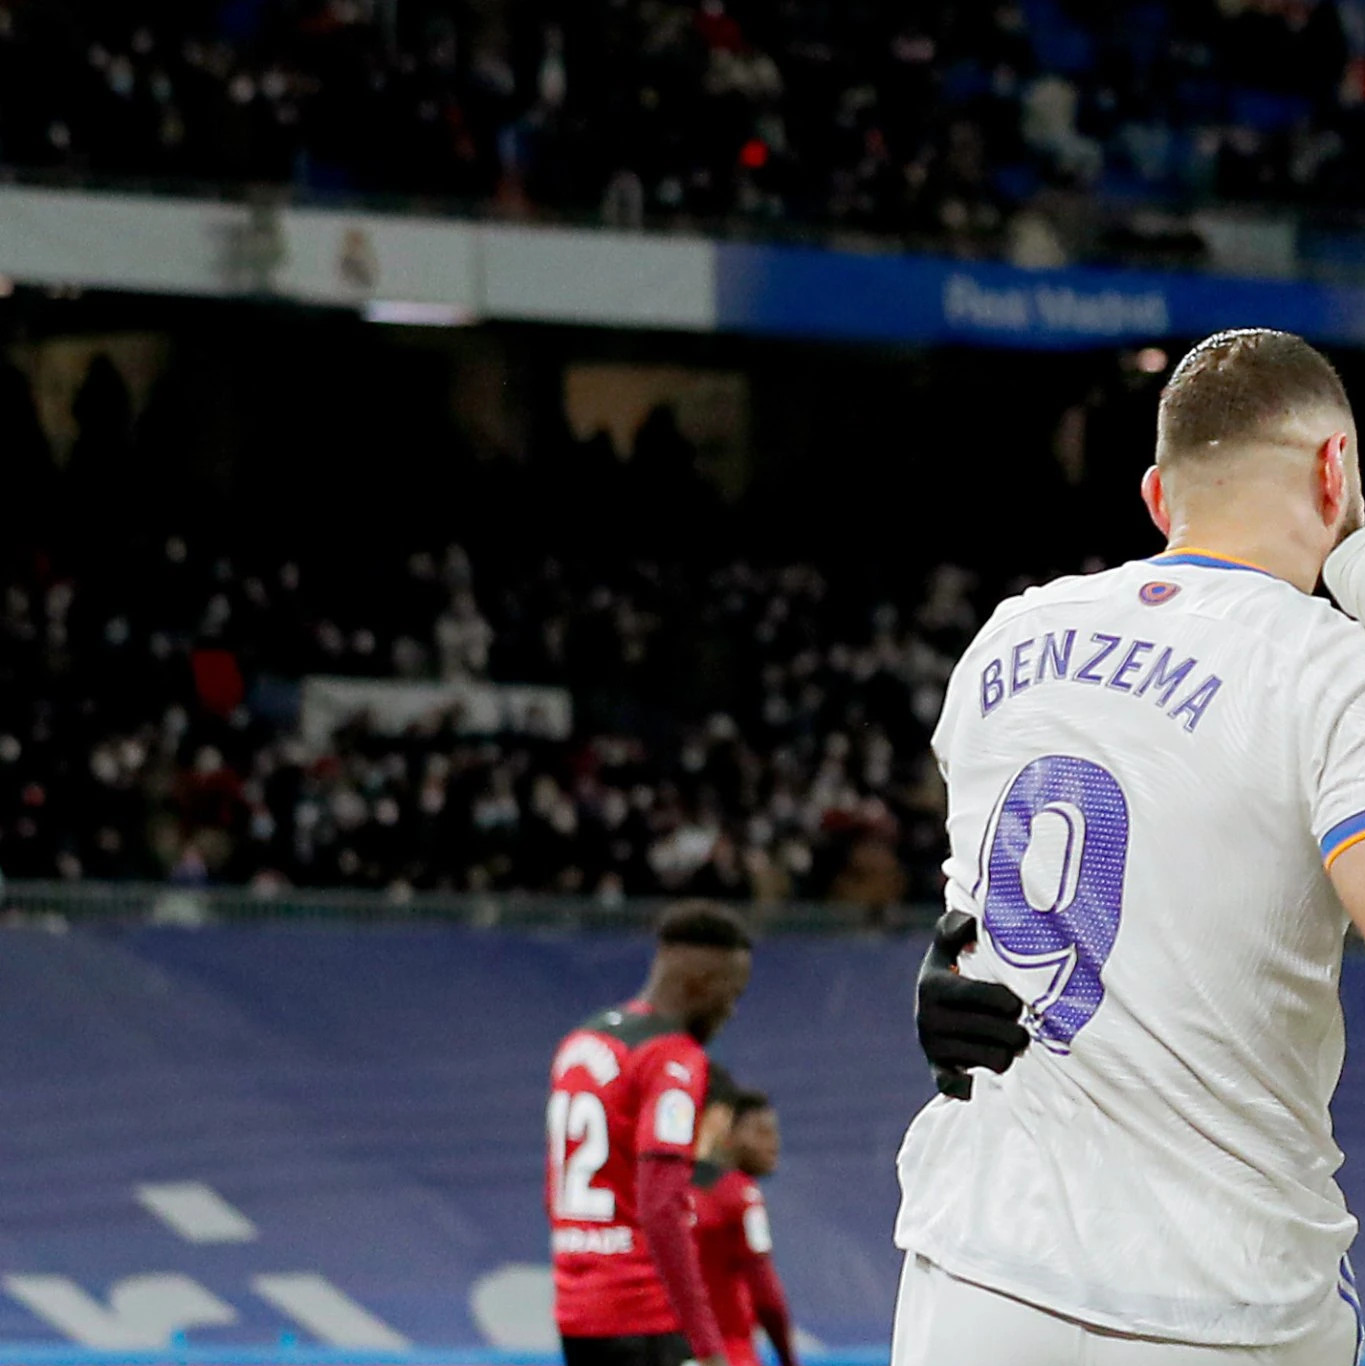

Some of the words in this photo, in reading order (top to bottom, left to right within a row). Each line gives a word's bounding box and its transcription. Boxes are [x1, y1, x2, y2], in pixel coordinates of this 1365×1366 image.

[980, 629, 1223, 733] BENZEMA
[972, 755, 1131, 1056] 9
[547, 1090, 616, 1222] 12
